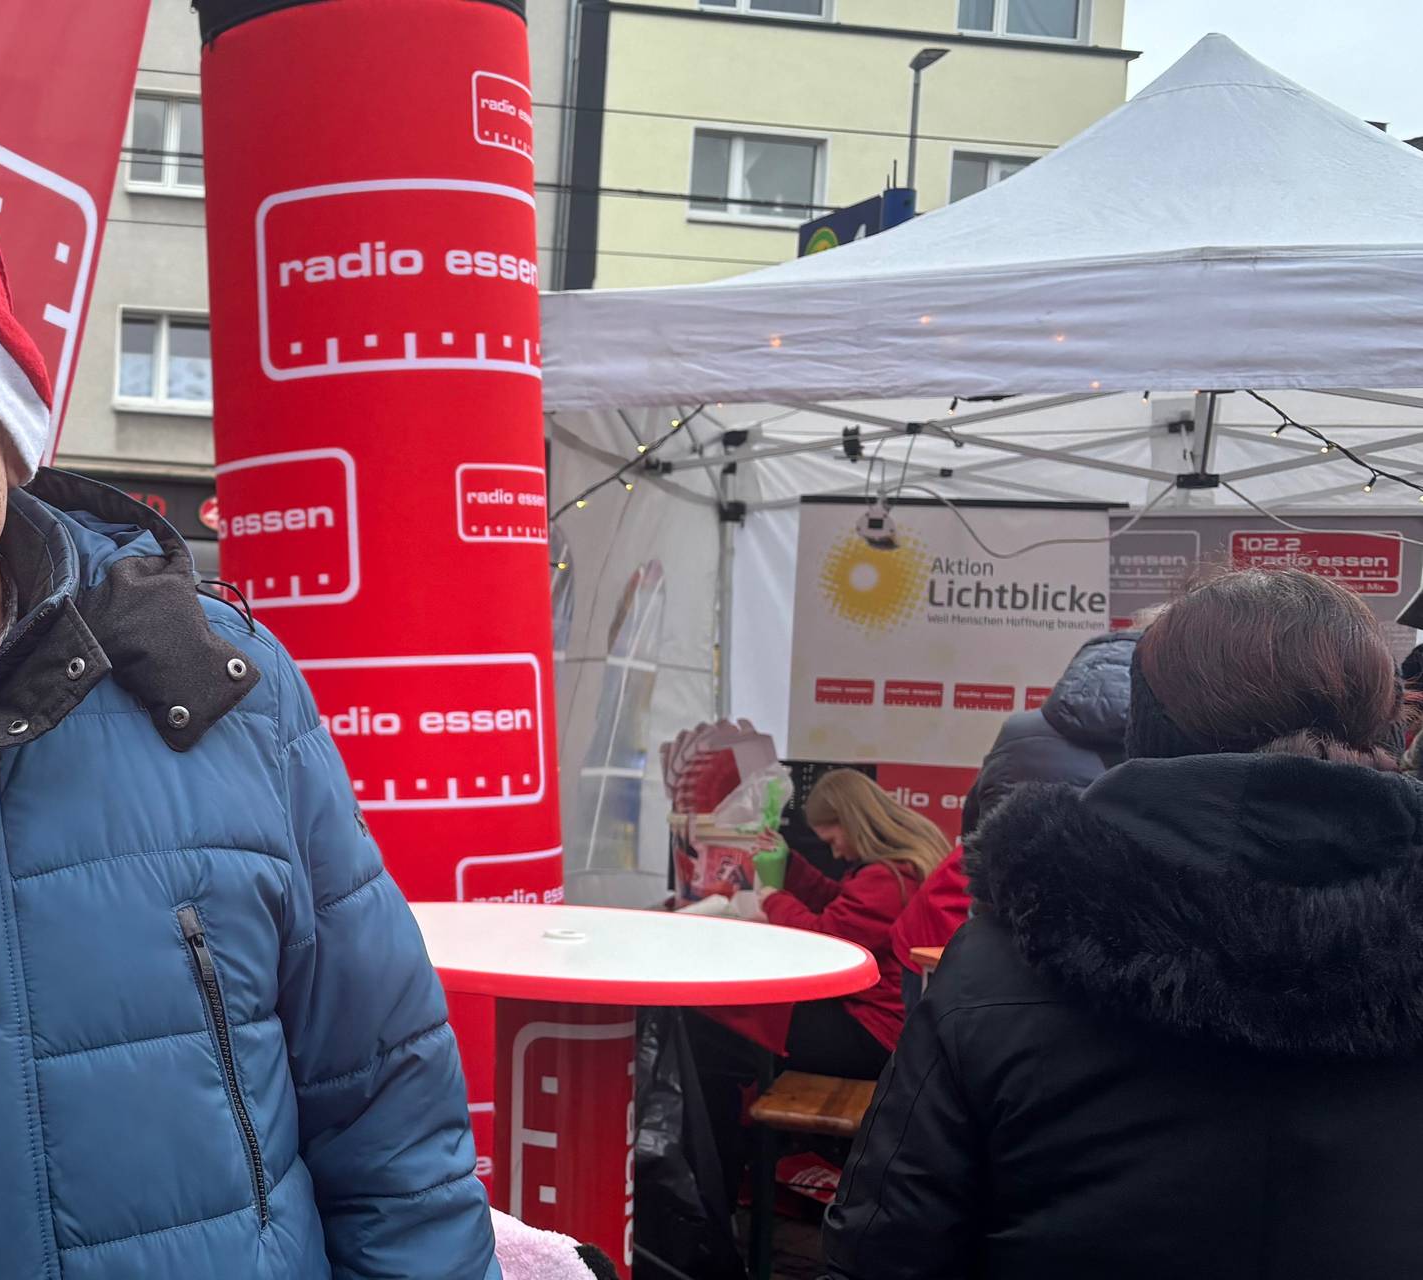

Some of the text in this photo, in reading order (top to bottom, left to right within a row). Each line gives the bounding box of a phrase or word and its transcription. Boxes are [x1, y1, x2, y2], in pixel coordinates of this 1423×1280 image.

[480, 97, 517, 117] radio
[279, 241, 424, 287] radio
[466, 488, 514, 505] radio
[231, 506, 334, 537] essen
[1239, 537, 1302, 552] 102.2
[931, 557, 994, 577] Aktion
[1249, 551, 1388, 569] radio essen
[928, 579, 1106, 613] Lichtblicke
[951, 613, 1004, 627] Menschen
[1006, 617, 1054, 631] Hoffnung
[1057, 619, 1105, 632] brauchen
[419, 708, 532, 734] essen
